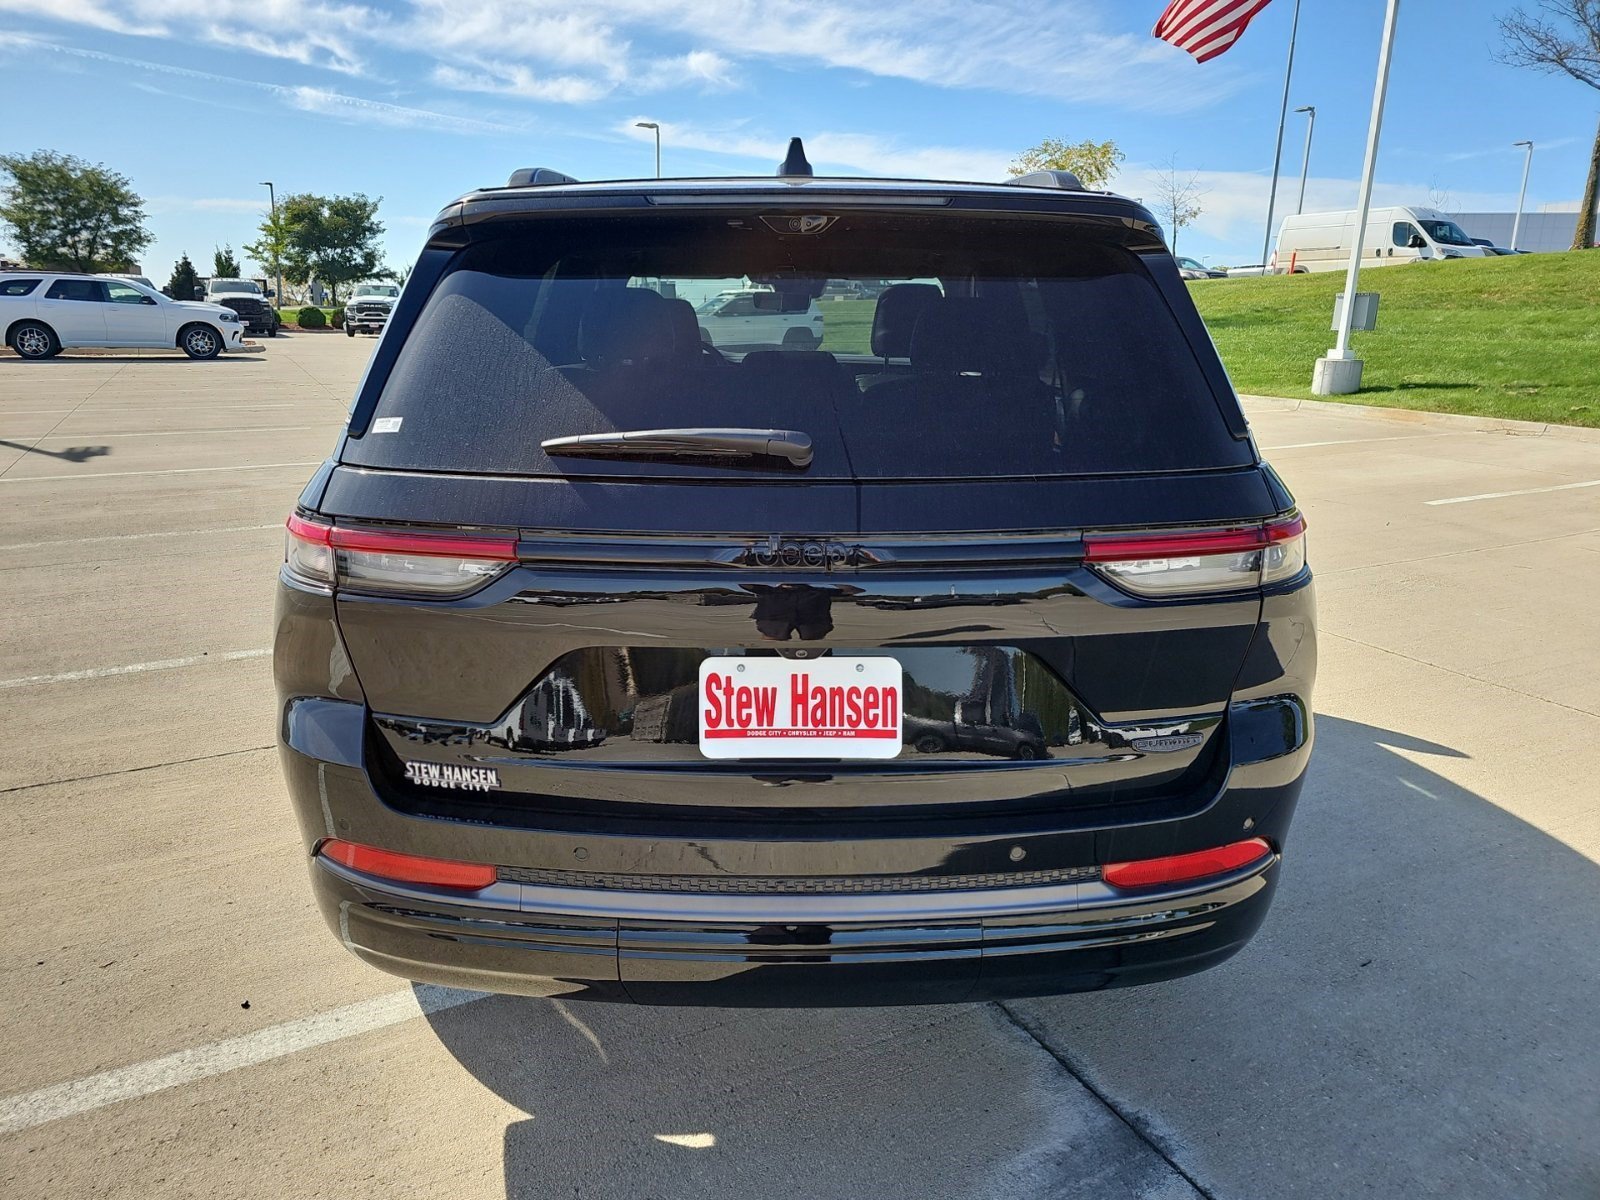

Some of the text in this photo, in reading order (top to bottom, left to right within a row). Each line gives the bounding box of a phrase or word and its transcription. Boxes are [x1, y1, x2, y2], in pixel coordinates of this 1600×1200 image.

[751, 535, 847, 572] Jeep
[705, 672, 897, 728] Stew Hansen
[405, 761, 496, 784] STEW HANSEN
[414, 778, 490, 792] DODGE CITY
